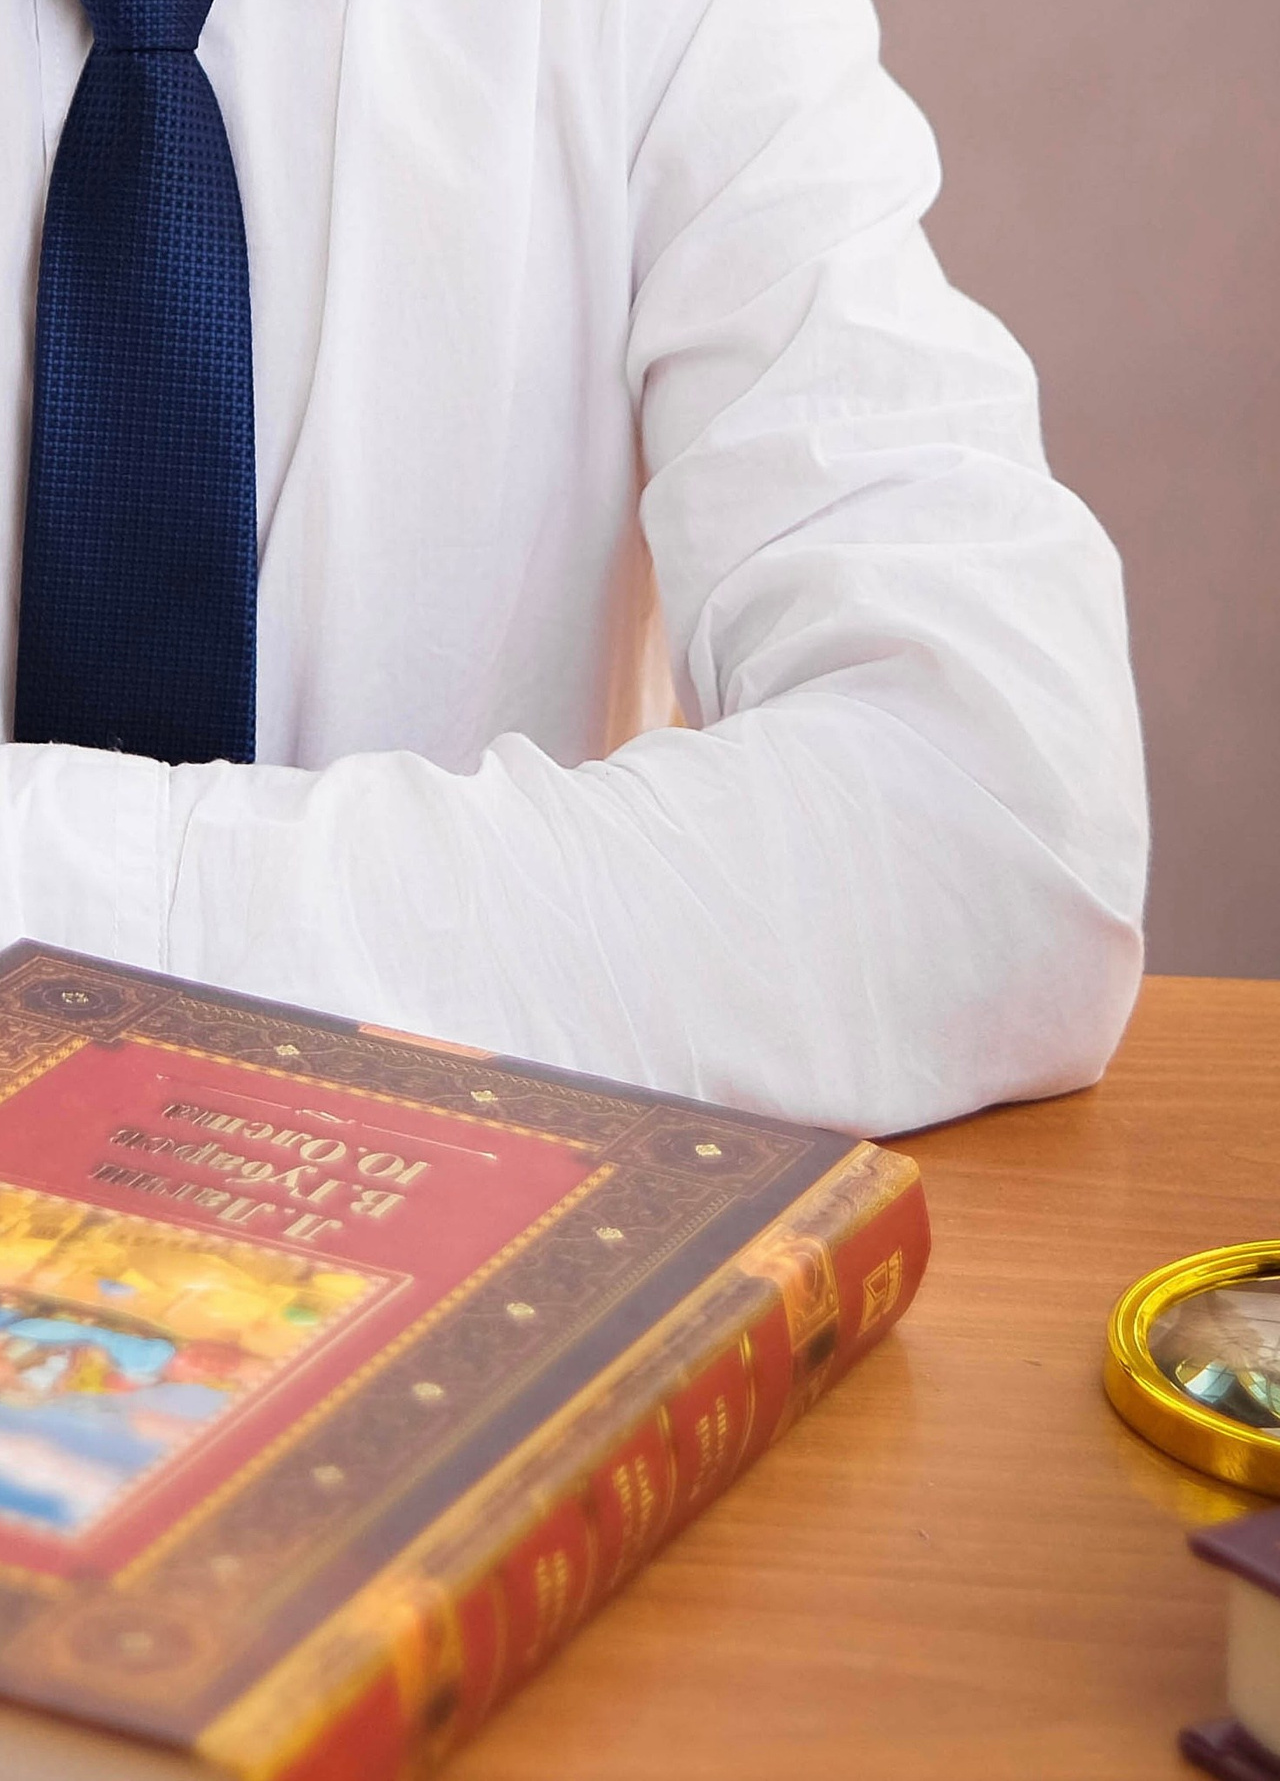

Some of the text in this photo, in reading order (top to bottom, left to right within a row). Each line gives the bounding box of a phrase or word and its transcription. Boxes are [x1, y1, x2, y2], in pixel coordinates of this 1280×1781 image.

[161, 1104, 347, 1162] Олеша
[88, 1162, 276, 1225] Лагин
[109, 1129, 346, 1203] Губарев
